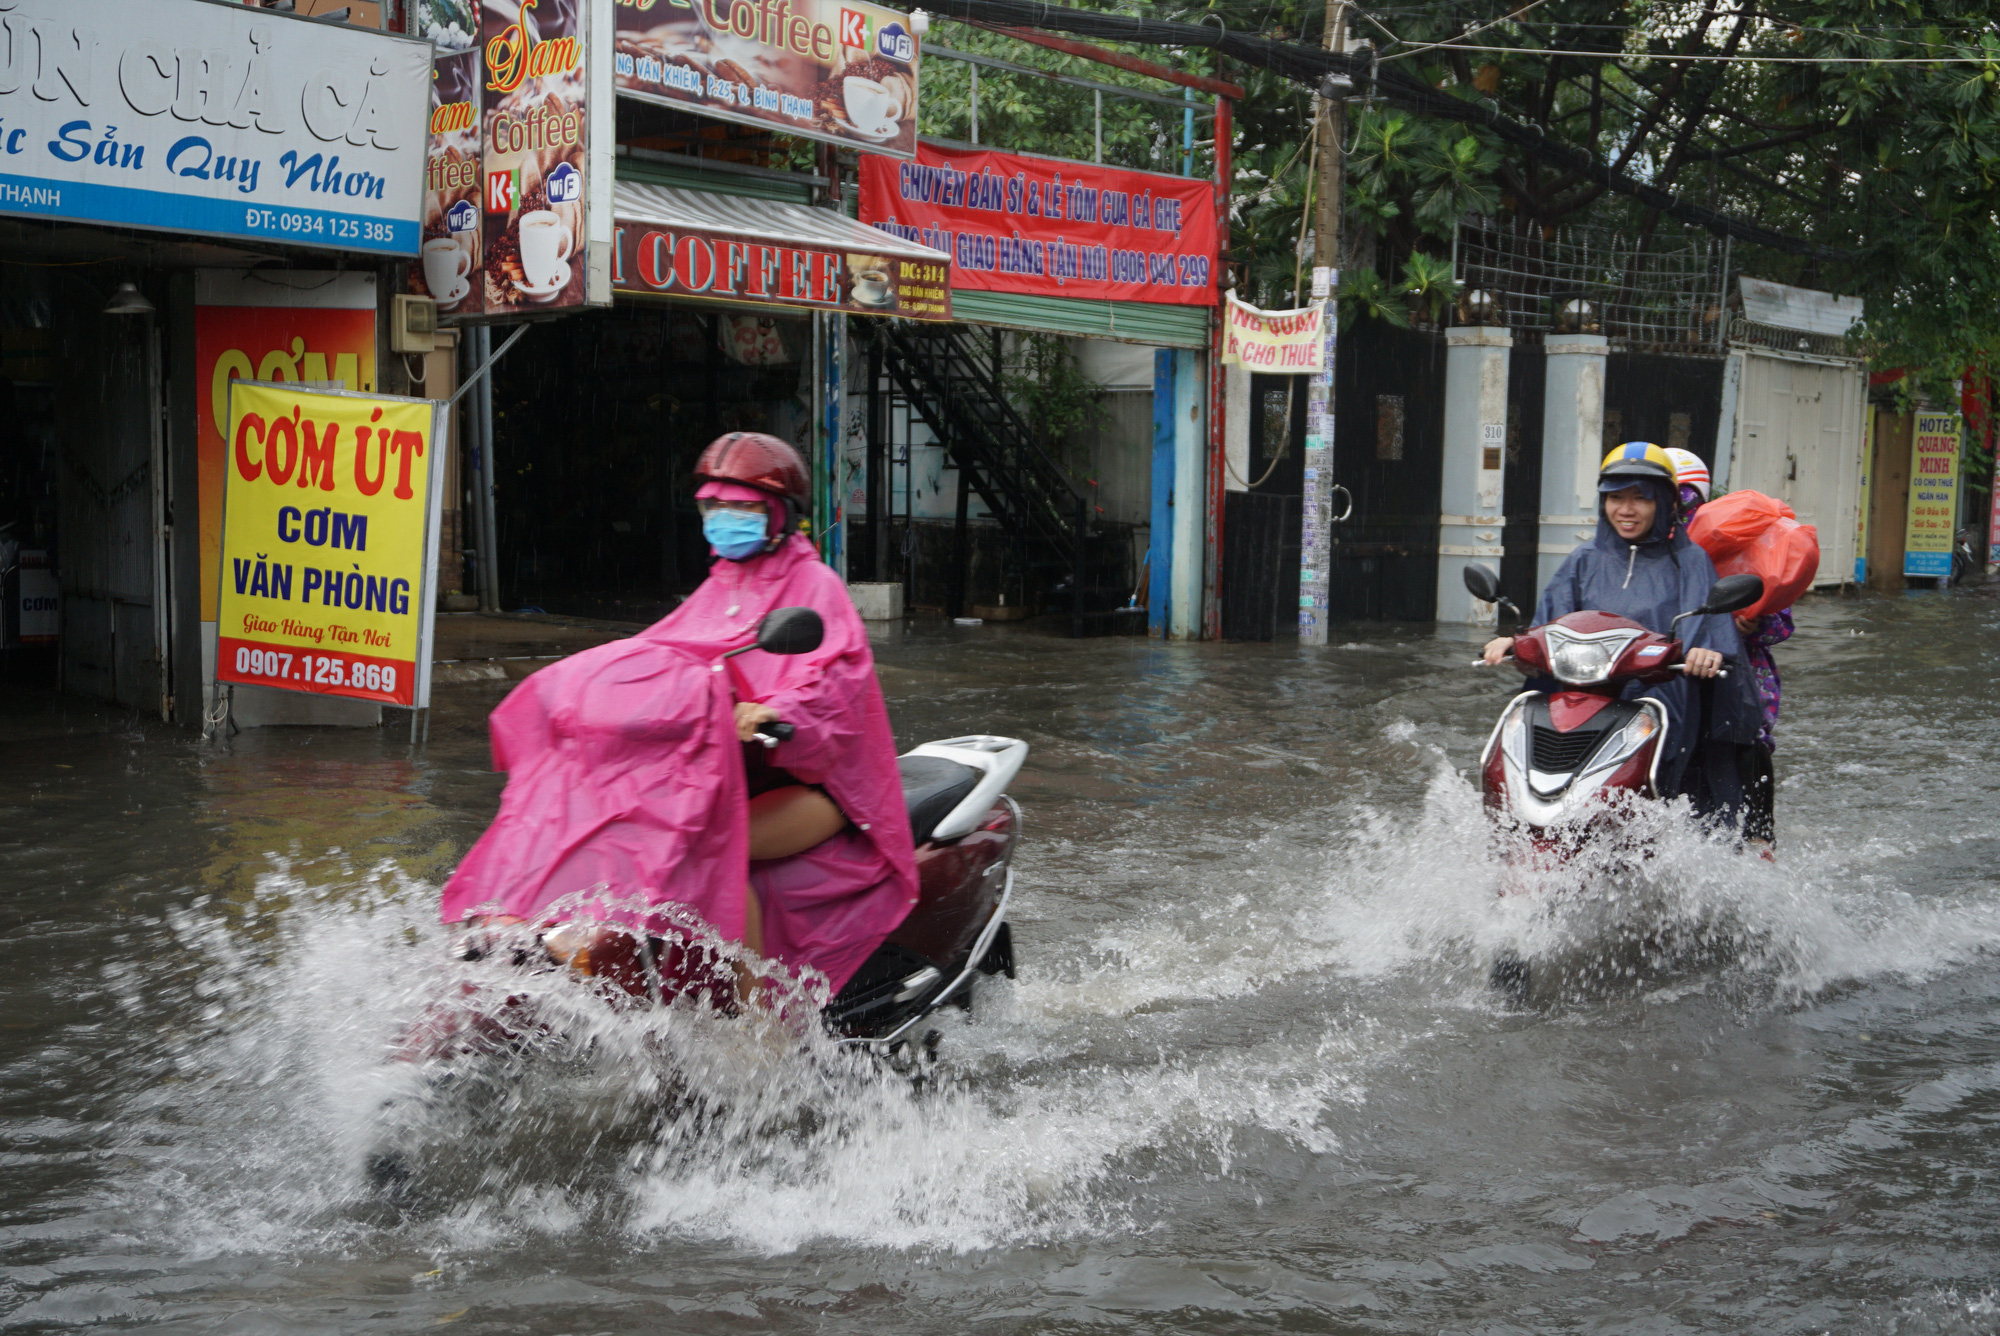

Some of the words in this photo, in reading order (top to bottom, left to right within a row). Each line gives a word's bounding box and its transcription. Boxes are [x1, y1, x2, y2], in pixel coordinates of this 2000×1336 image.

[486, 0, 582, 92] Sam
[702, 0, 833, 60] Coffee
[616, 53, 634, 77] NG
[636, 56, 661, 82] VĂN
[753, 84, 779, 111] BÌNH
[780, 94, 813, 120] THẠNH
[430, 101, 478, 135] am
[491, 106, 579, 155] Coffee
[47, 119, 145, 170] Sản
[166, 135, 261, 193] Quy
[279, 149, 386, 200] Nhơn
[427, 156, 475, 191] ffee
[899, 161, 966, 207] CHUYÊN
[967, 166, 1003, 211] BÁN
[1027, 180, 1040, 216] &
[1043, 172, 1063, 219] LẺ
[1065, 179, 1098, 222] TÔM
[1101, 189, 1129, 226] CUA
[1132, 188, 1151, 229] CÁ
[1154, 196, 1182, 239] GHẸ
[246, 208, 276, 230] ĐT:
[280, 213, 324, 233] 0934
[329, 218, 359, 238] 125
[364, 221, 394, 242] 385
[637, 230, 842, 305] COFFEE
[923, 264, 945, 283] 314
[957, 232, 995, 271] GIAO
[999, 231, 1044, 275] HÀNG
[1047, 235, 1077, 285] TẬN
[1111, 249, 1147, 283] 0906
[1149, 252, 1177, 286] 040
[1179, 254, 1209, 286] 299
[1242, 341, 1277, 366] CHO
[1280, 340, 1317, 366] THUÊ
[235, 404, 340, 491] CƠM
[354, 406, 424, 500] ÚT
[1484, 426, 1502, 438] 310
[1917, 436, 1955, 453] QUANG
[1919, 457, 1950, 474] MINH
[1924, 478, 1936, 487] CHO
[277, 506, 368, 551] CƠM
[1942, 520, 1951, 529] 20
[233, 552, 293, 601] VĂN
[302, 563, 410, 615] PHÒNG
[243, 613, 279, 633] Giao
[281, 618, 325, 643] Hàng
[328, 624, 359, 645] Tận
[362, 628, 392, 648] Nơi
[236, 646, 397, 693] 0907.125.869
